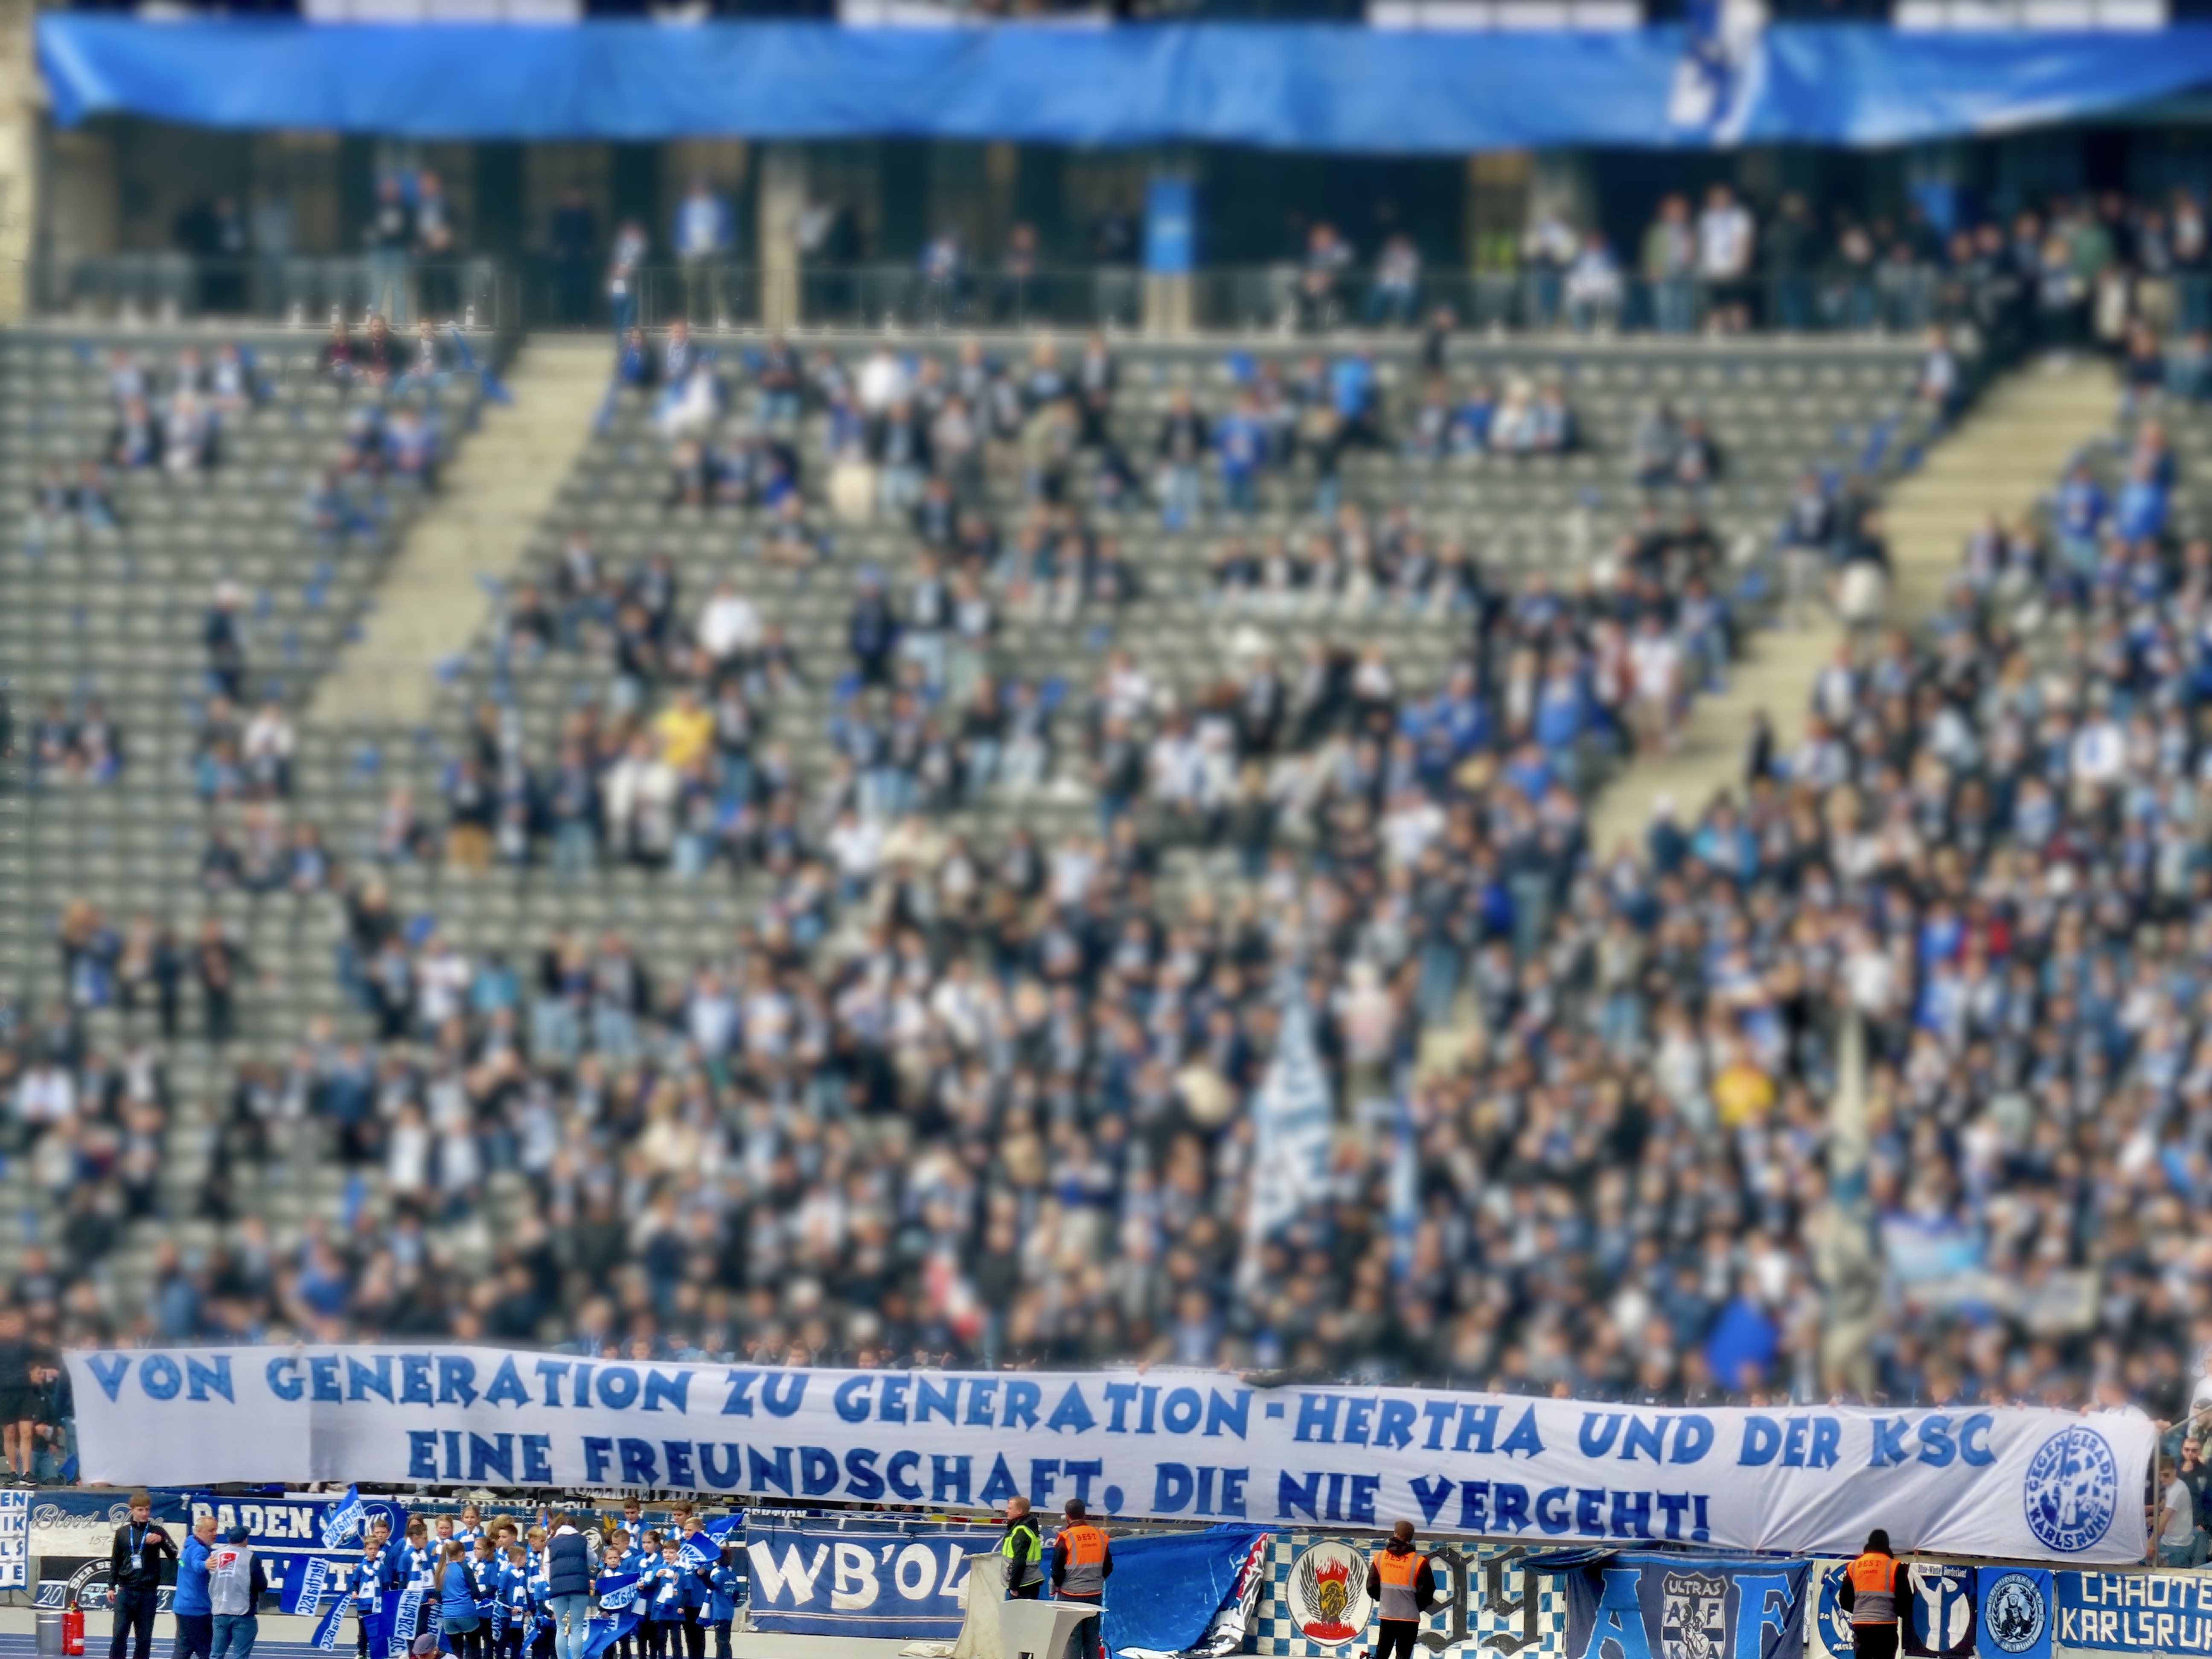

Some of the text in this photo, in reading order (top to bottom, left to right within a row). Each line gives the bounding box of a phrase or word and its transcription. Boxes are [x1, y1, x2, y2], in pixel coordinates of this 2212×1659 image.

[87, 1354, 235, 1404] VON
[265, 1353, 693, 1415] GENERATION
[721, 1369, 809, 1419] ZU
[1578, 1412, 1714, 1465] UND
[1736, 1414, 1841, 1469] DER
[1868, 1414, 1997, 1469] KSC
[406, 1428, 553, 1485] EINE
[1150, 1461, 1250, 1520] DIE
[1274, 1469, 1381, 1527] NIE
[1407, 1473, 1711, 1543] VERGEHT!
[31, 1503, 99, 1530] Blood
[192, 1502, 314, 1539] BADEN
[1076, 1533, 1097, 1541] BEST
[1385, 1553, 1409, 1563] BEST
[1857, 1560, 1880, 1568] BEST
[38, 1585, 63, 1604] 20
[1668, 1579, 1722, 1596] ULTRAS
[1707, 1603, 1719, 1623] F
[1819, 1612, 1830, 1620] 20
